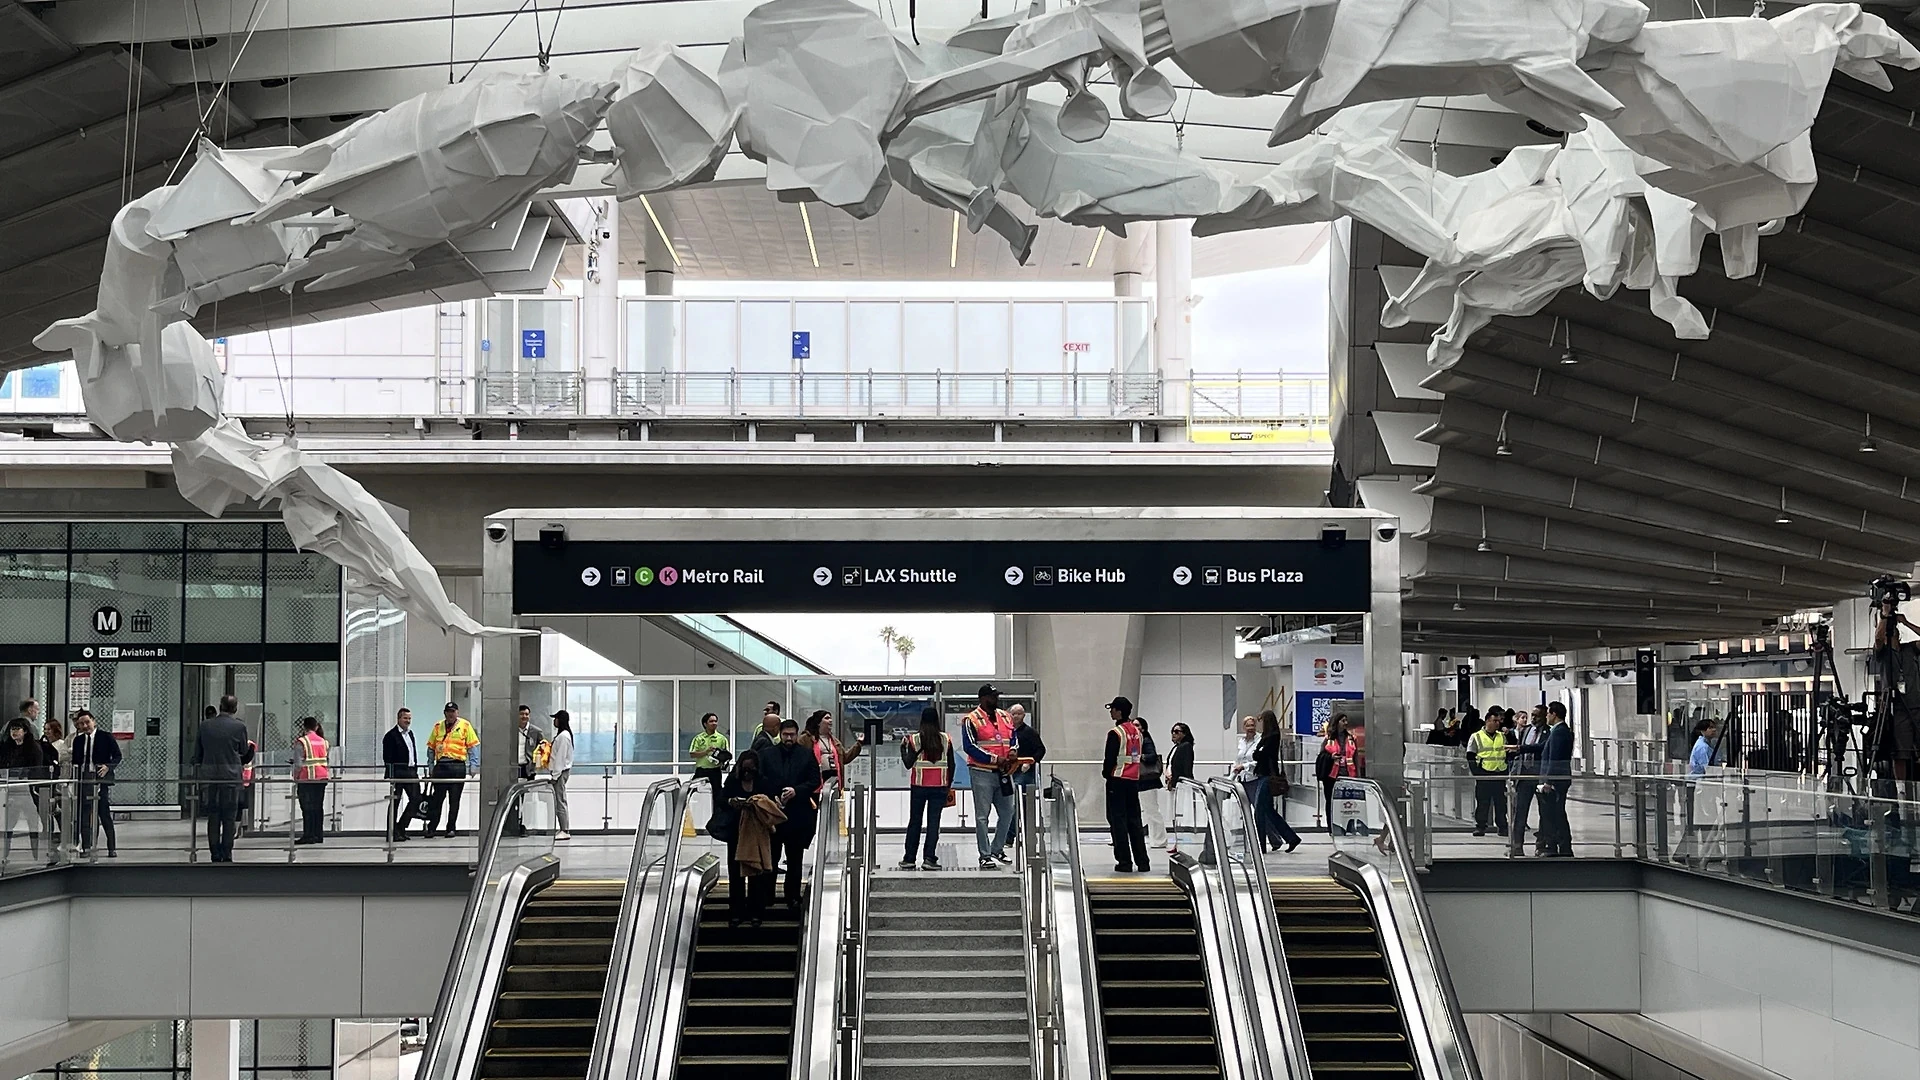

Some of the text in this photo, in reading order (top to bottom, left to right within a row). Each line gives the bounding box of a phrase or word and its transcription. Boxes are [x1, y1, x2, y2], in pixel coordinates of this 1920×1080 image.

[1069, 343, 1090, 351] EXIT
[640, 568, 765, 584] C K Metro Rail
[864, 568, 957, 583] LAX Shuttle
[1058, 568, 1126, 583] Bike Hub
[1226, 568, 1304, 583] Bus Plaza
[97, 611, 117, 631] M
[100, 648, 167, 657] Exit Aviation Bl
[1333, 662, 1342, 671] M
[842, 684, 932, 693] LAX/Metro Transit Center
